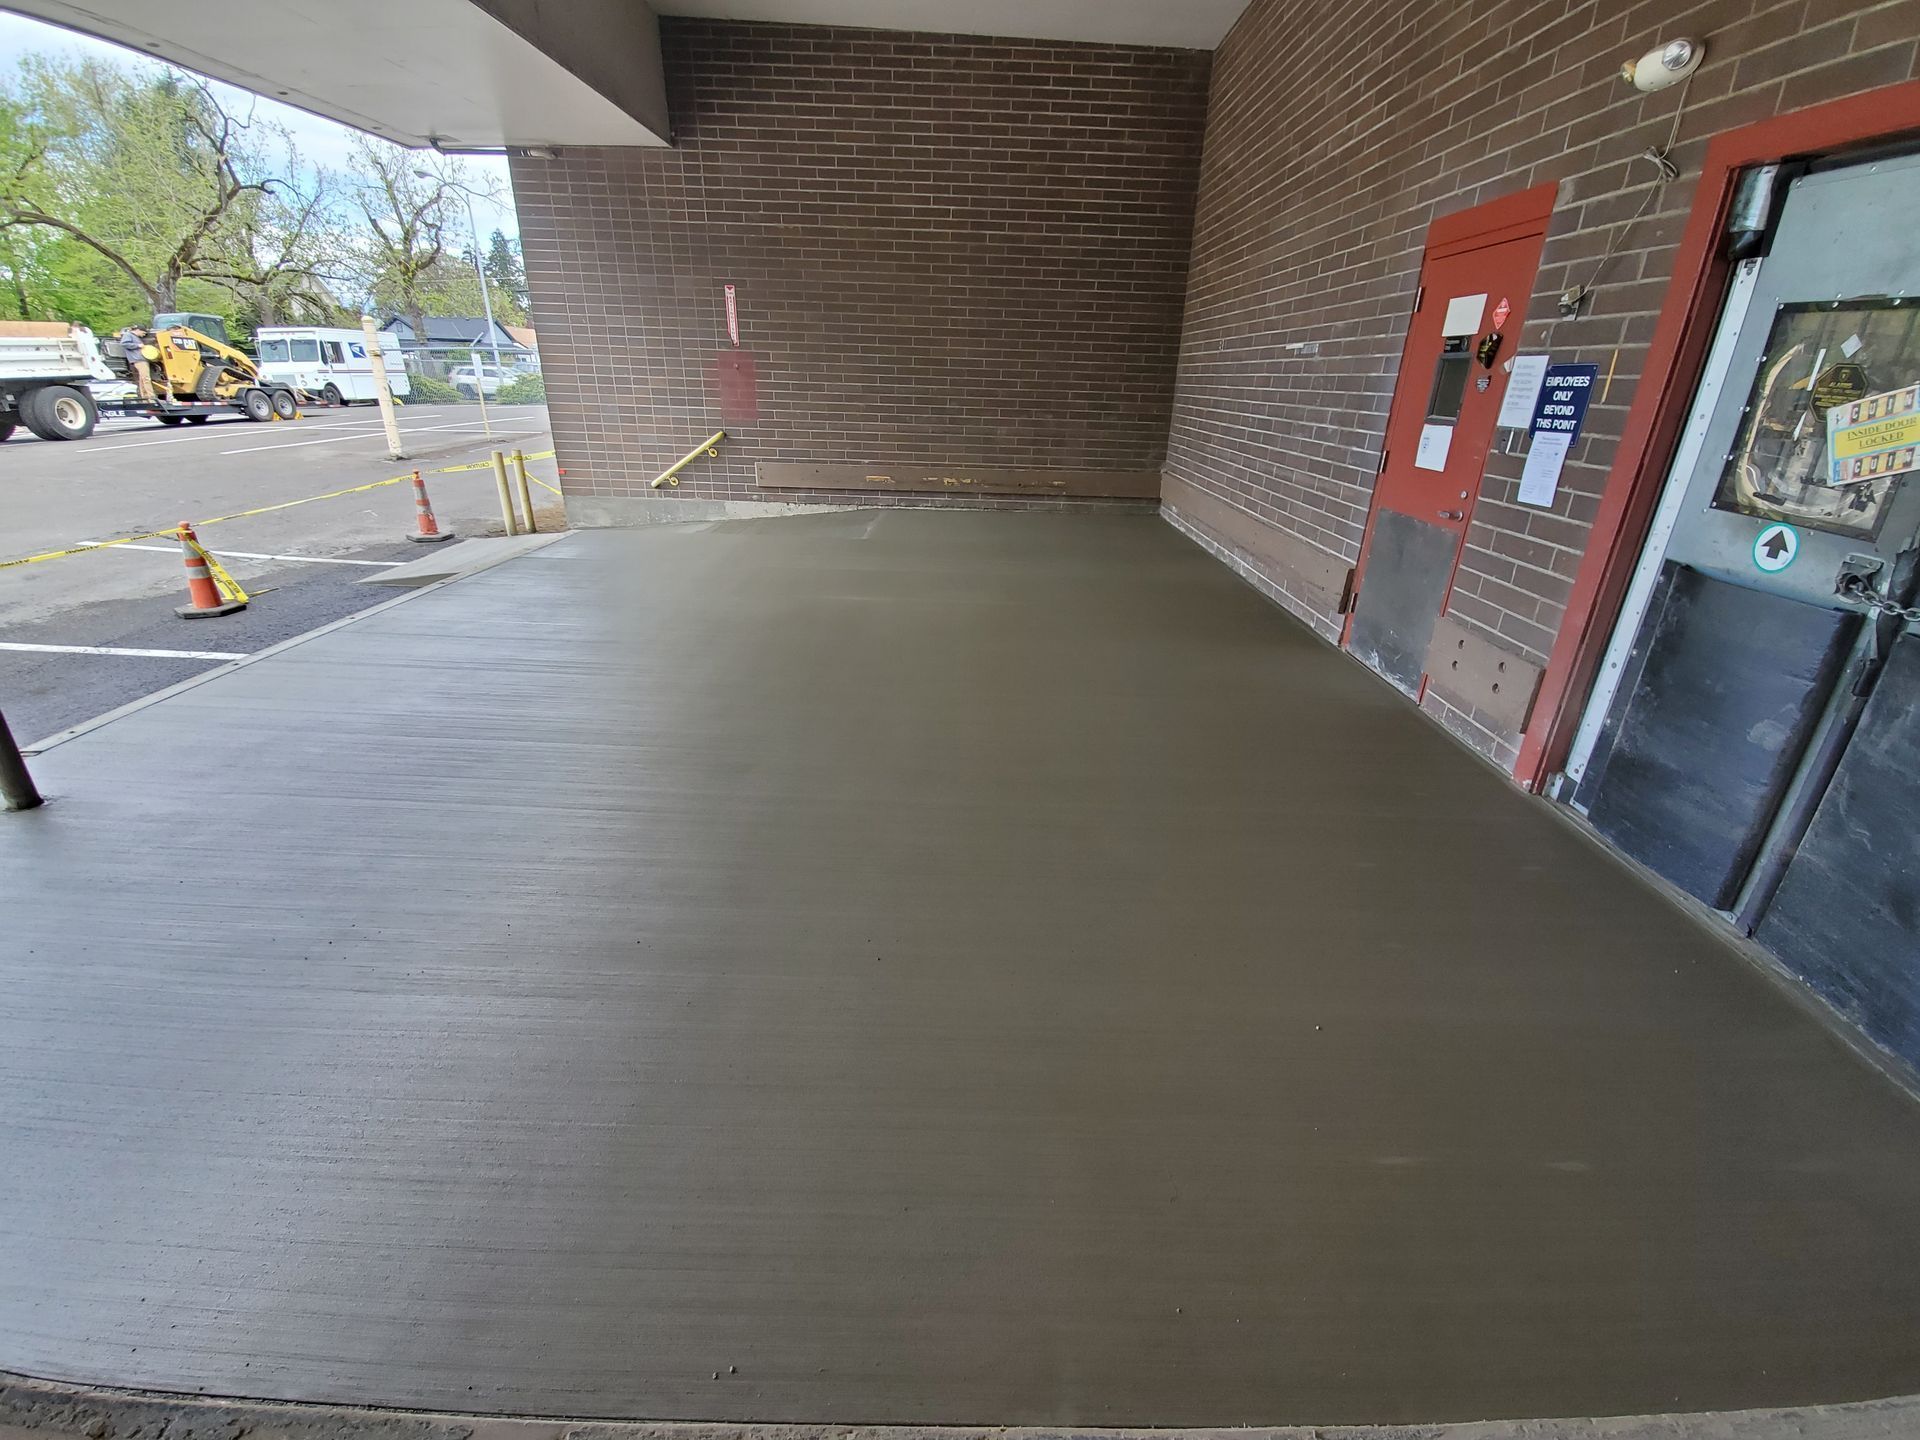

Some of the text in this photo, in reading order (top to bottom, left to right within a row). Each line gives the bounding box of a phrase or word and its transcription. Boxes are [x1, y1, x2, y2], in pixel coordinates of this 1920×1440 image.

[183, 339, 197, 350] CAT
[1545, 376, 1590, 387] EMPLOYEES
[1552, 390, 1574, 401] ONLY
[1543, 404, 1575, 416] BEYOND
[1536, 418, 1577, 430] THIS POINT
[1847, 416, 1917, 440] INSIDE DOOR
[1859, 431, 1904, 448] LOCKED
